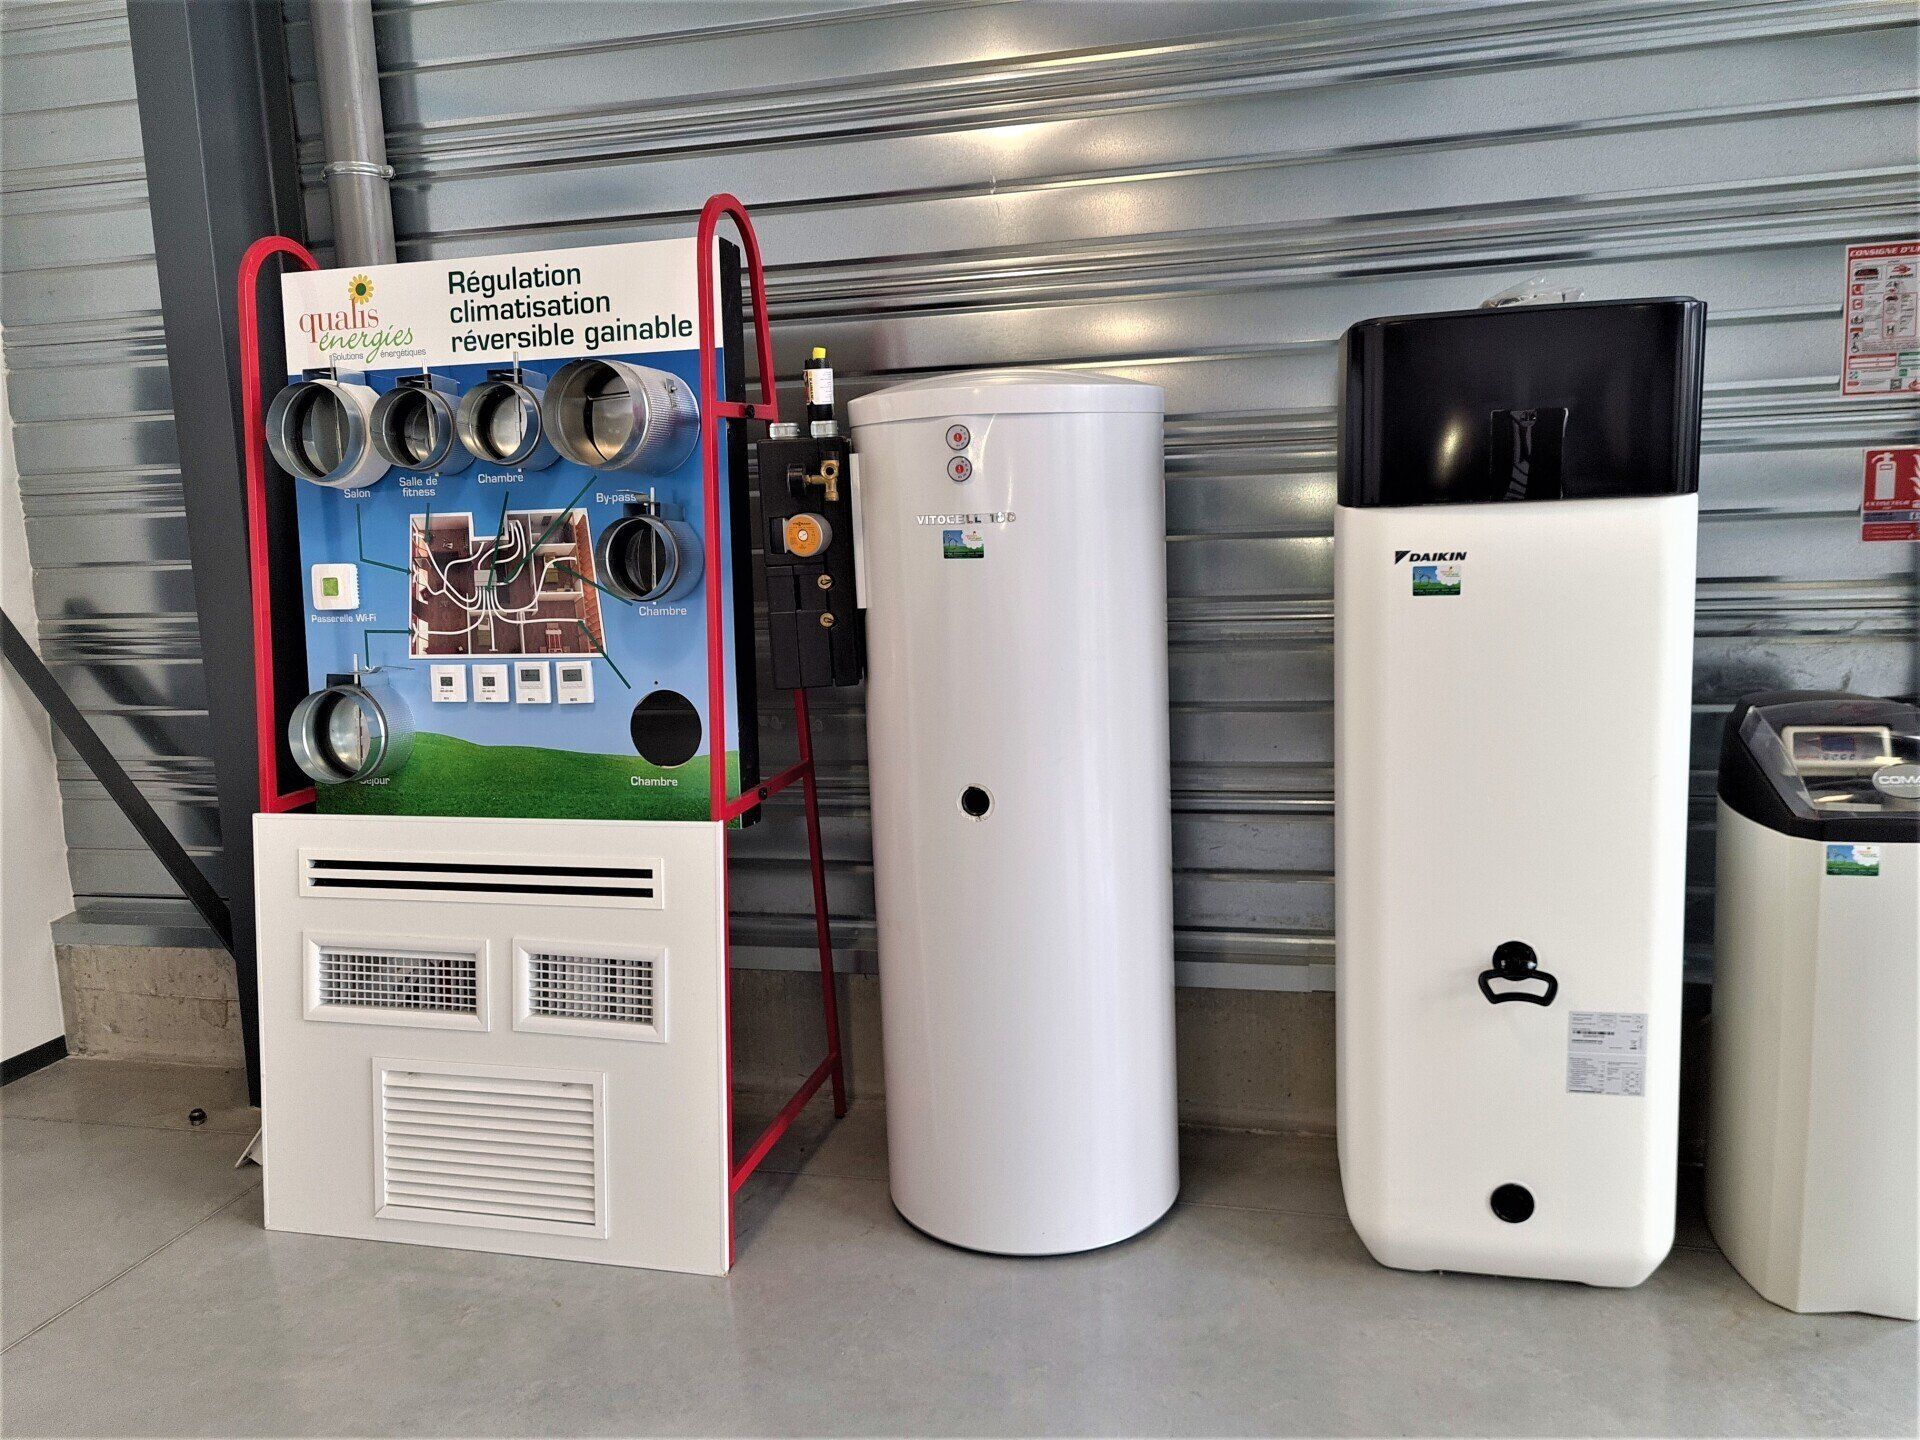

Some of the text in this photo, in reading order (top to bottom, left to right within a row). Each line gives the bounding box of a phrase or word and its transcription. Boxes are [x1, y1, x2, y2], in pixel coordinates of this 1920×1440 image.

[448, 264, 581, 298] Régulation
[450, 291, 611, 323] climatisation
[299, 297, 379, 343] qualis
[451, 313, 693, 352] réversible gainable
[319, 325, 414, 363] énergies
[332, 348, 427, 361] Solutions énergétiques
[398, 477, 438, 487] Salle de
[477, 473, 524, 484] Chambre
[344, 489, 371, 498] Salon
[402, 487, 436, 497] fitness
[596, 492, 637, 505] By-pass
[916, 514, 982, 525] VITOCELL
[1409, 552, 1467, 562] DAIKIN
[639, 606, 687, 617] Chambre
[311, 613, 377, 623] Passerelle Wi-Fi
[630, 776, 678, 787] Chambre
